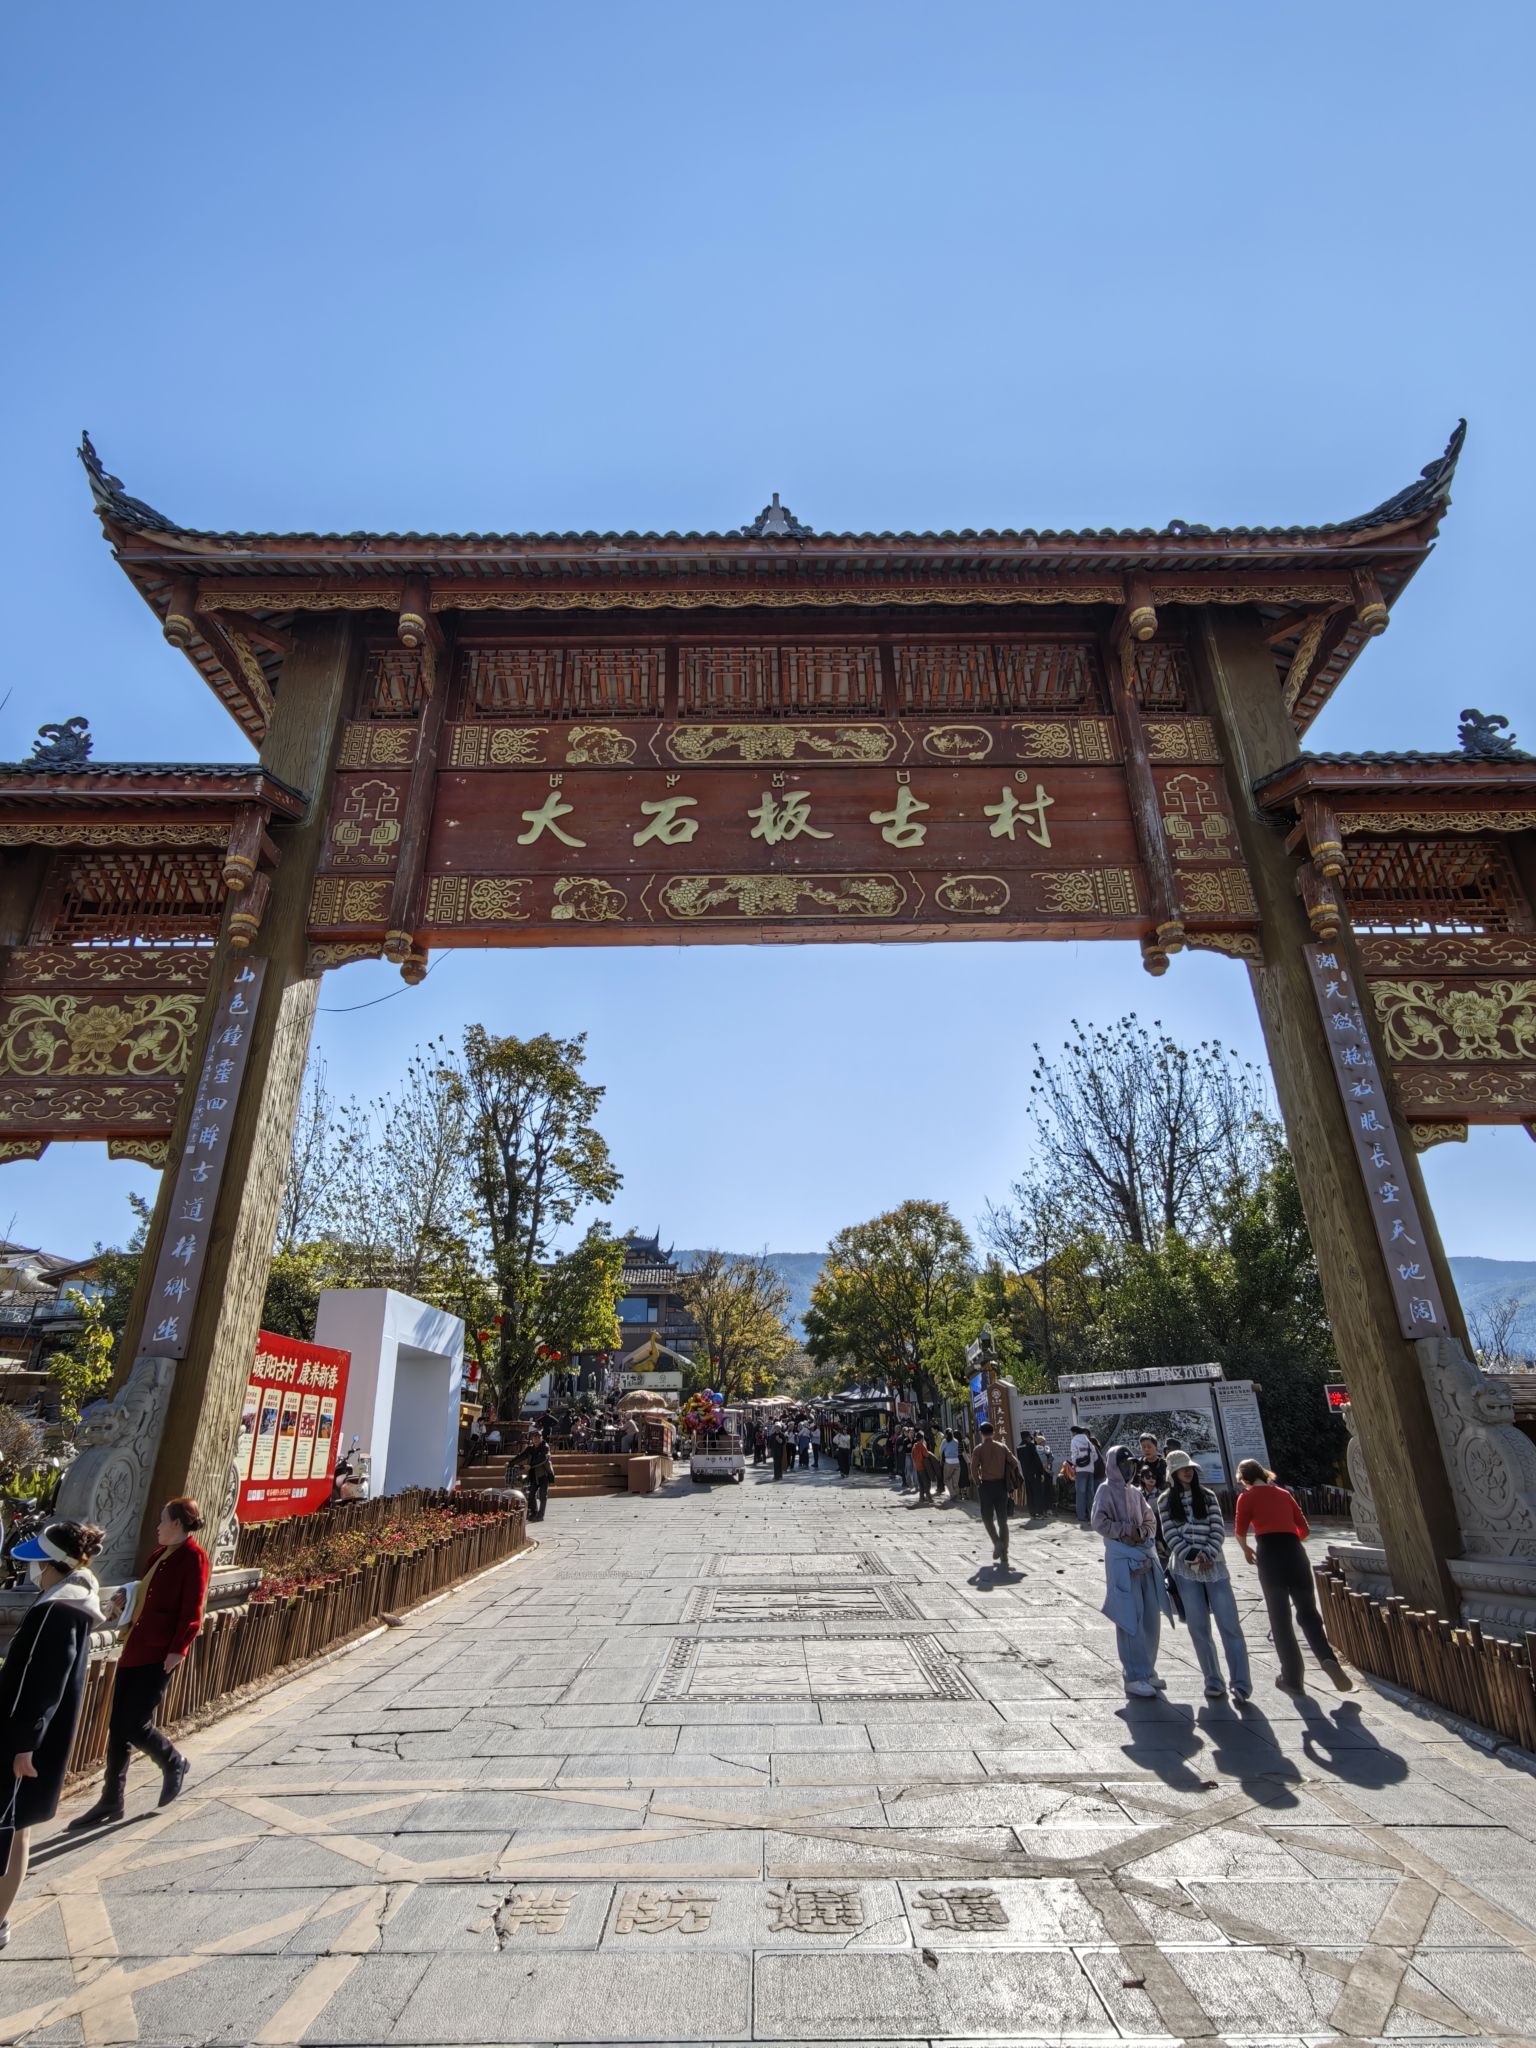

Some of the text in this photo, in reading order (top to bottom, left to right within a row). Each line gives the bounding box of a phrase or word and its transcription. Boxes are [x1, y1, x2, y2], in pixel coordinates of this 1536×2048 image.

[516, 784, 1055, 848] 大石板古村
[252, 1351, 339, 1391] 暖阳古村 康养新春
[466, 1886, 1009, 1936] 消防通道
